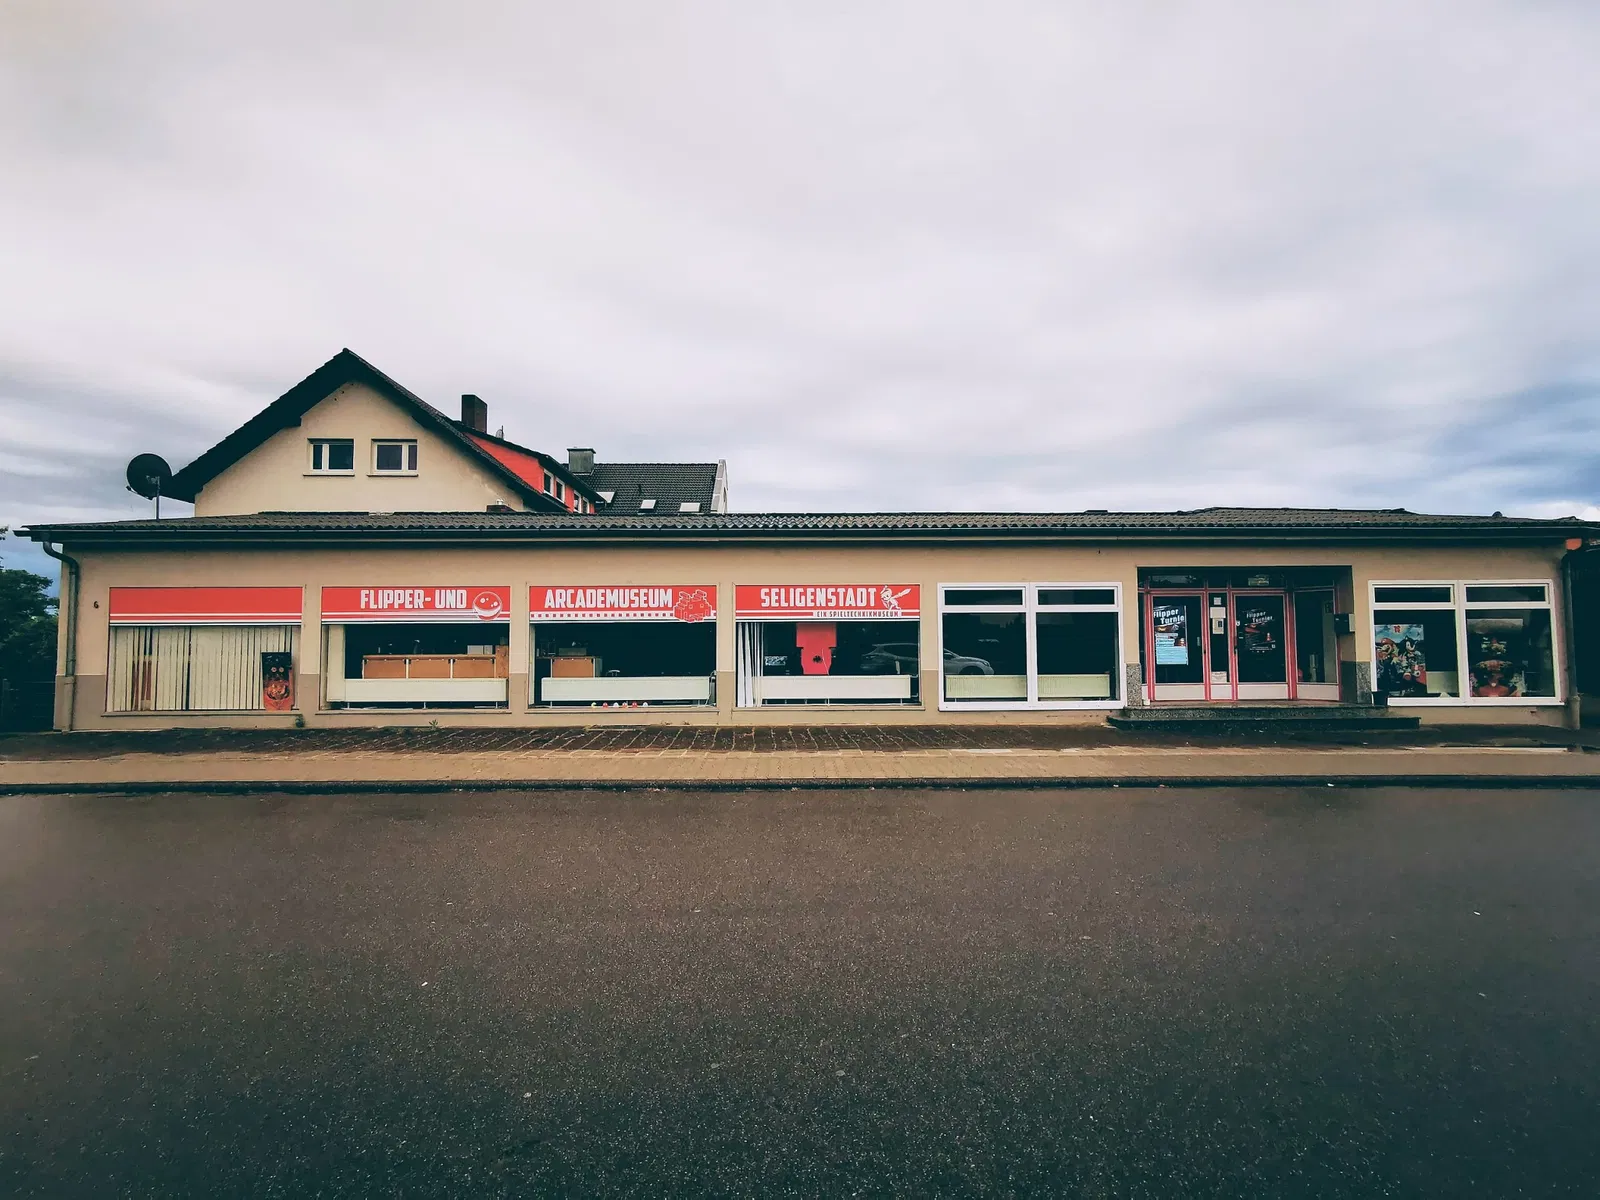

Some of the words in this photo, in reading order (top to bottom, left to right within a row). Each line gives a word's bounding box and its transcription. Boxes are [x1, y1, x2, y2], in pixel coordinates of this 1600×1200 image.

[93, 600, 99, 609] 6
[360, 589, 431, 609] FLIPPER-
[434, 589, 467, 609] UND
[544, 588, 673, 608] ARCADEMUSEUM
[760, 587, 877, 607] SELIGENSTADT
